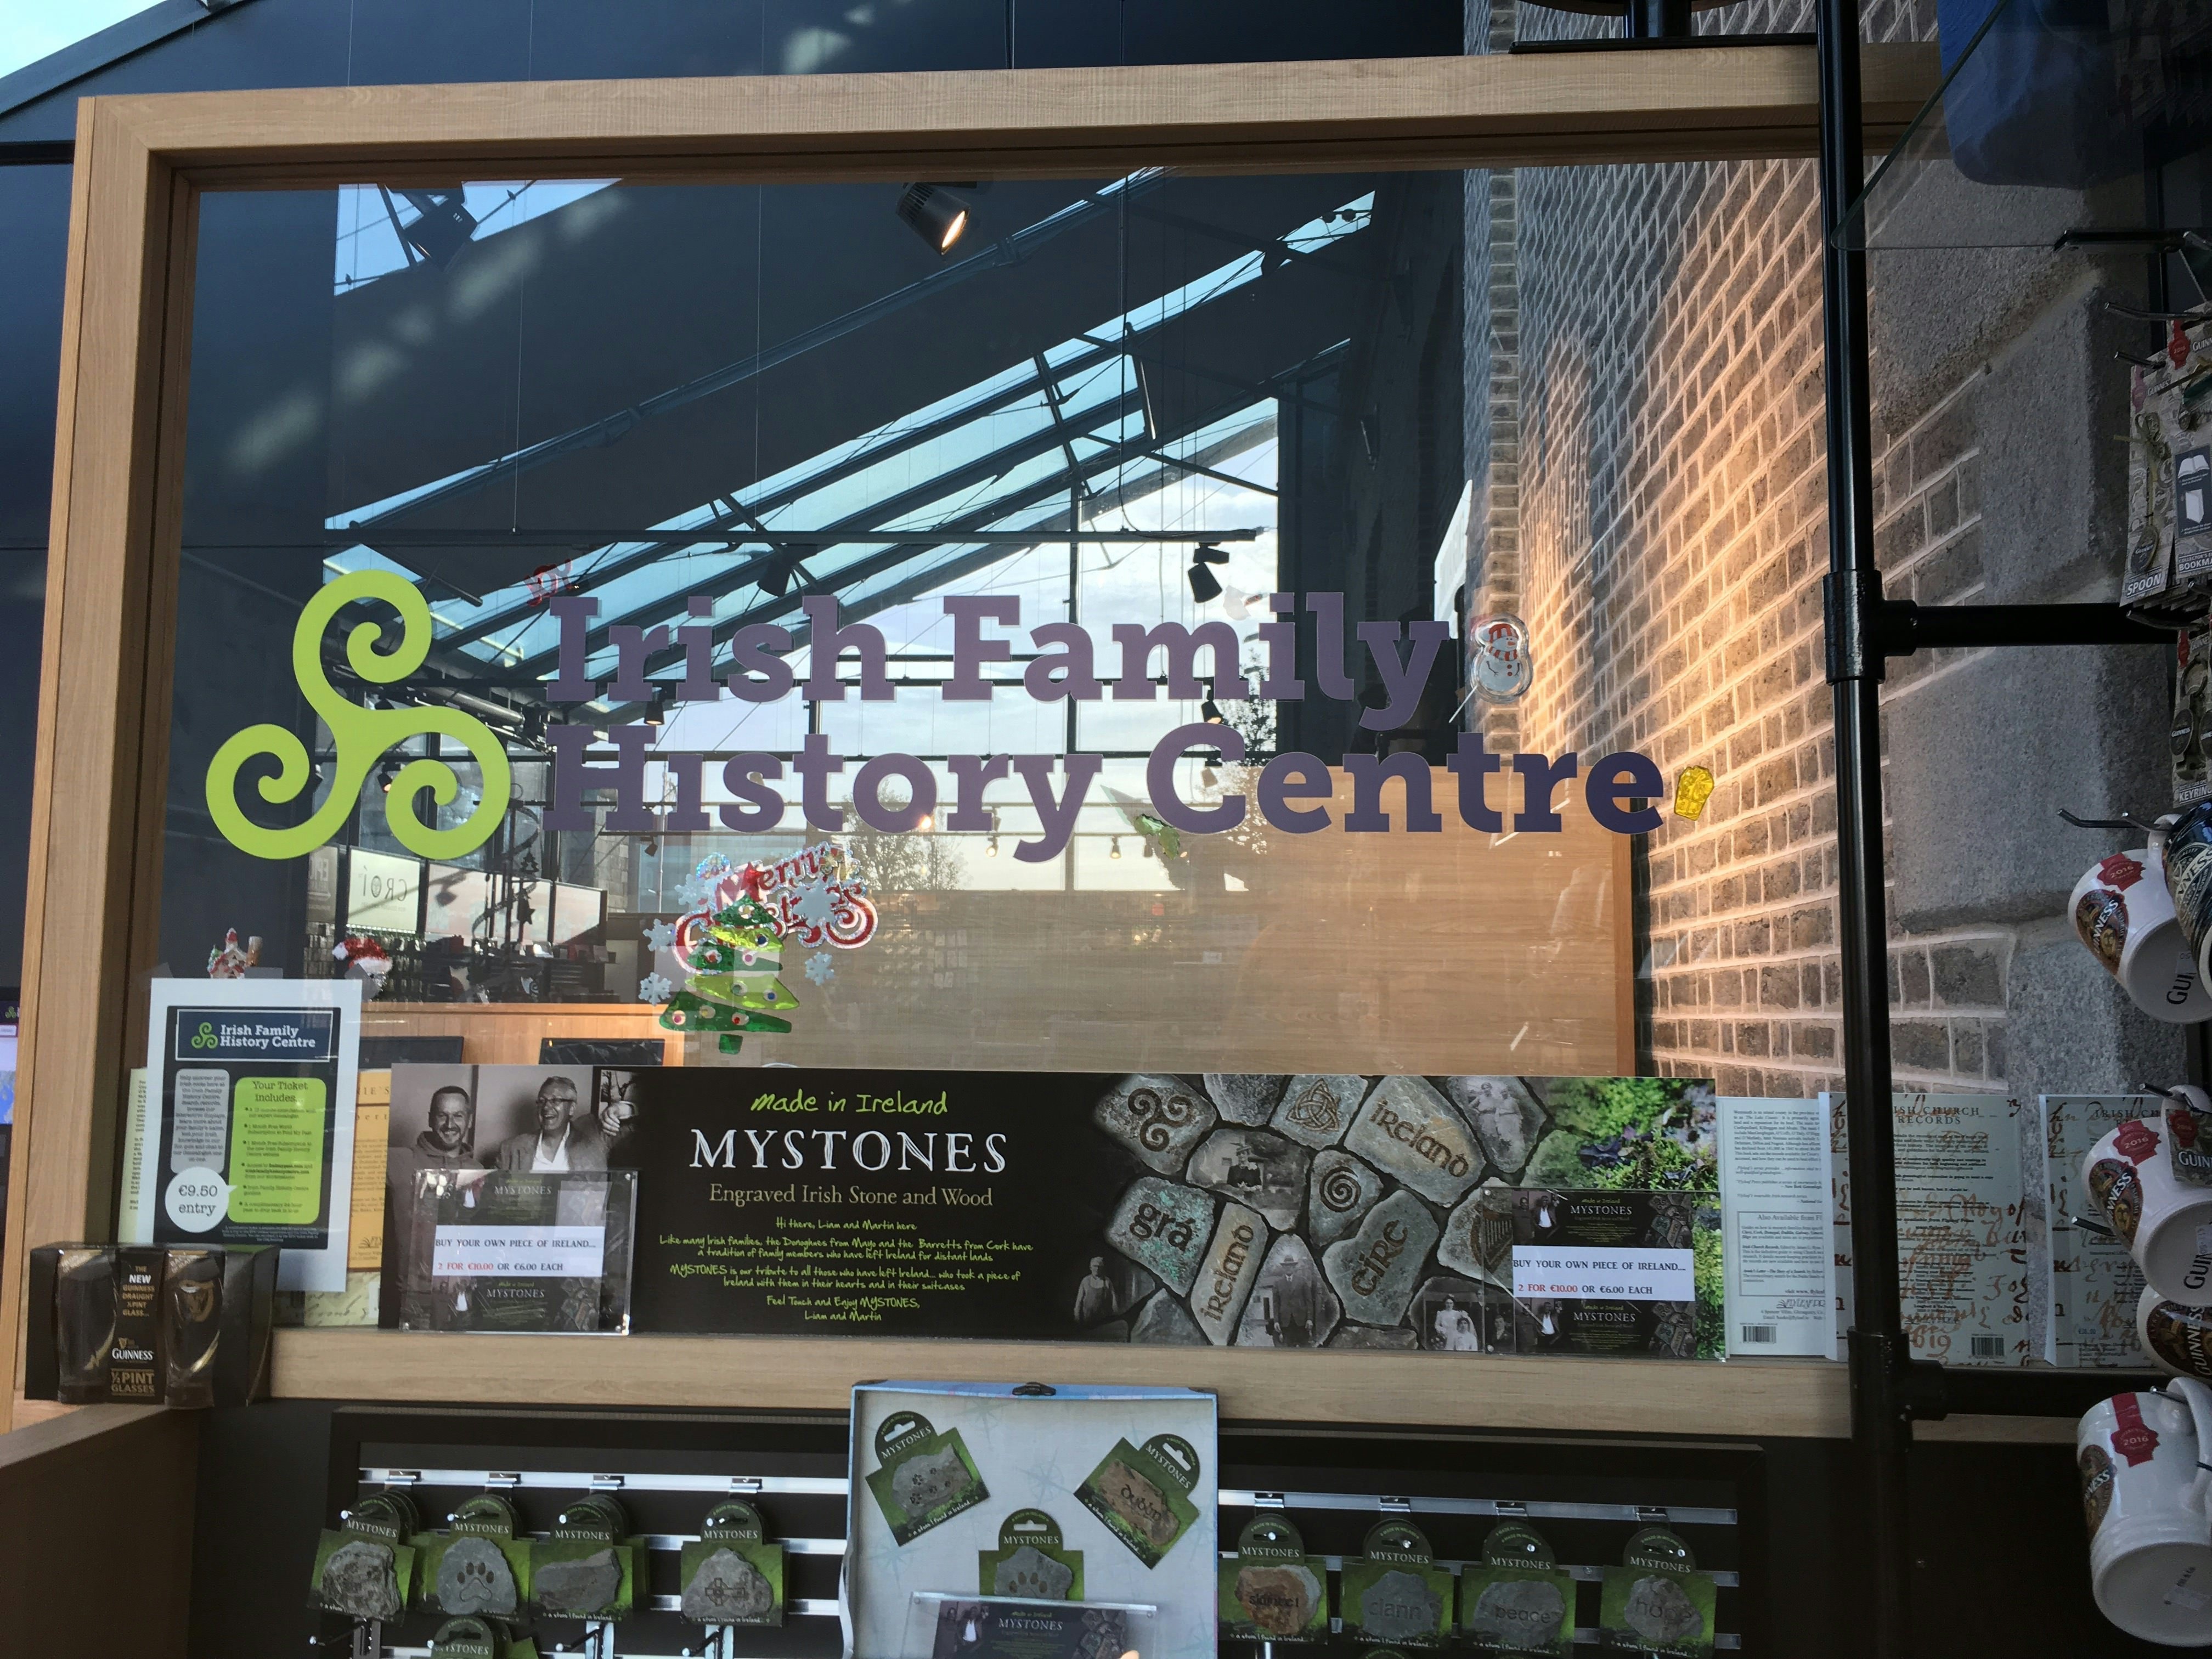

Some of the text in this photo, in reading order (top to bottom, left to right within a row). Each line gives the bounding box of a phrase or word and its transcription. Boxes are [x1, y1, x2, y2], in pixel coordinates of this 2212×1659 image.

[2127, 573, 2162, 596] SPOON
[549, 592, 1450, 731] Irish Family
[544, 723, 1664, 864] History Centre
[2111, 866, 2134, 878] 2016
[221, 1024, 299, 1037] Irish Family
[220, 1036, 316, 1049] History Centre
[252, 1081, 308, 1090] Your Ticket
[750, 1088, 947, 1115] made in Ireland
[1923, 1107, 1979, 1115] CHURCH
[2096, 1109, 2133, 1118] IRISH
[1898, 1116, 1961, 1125] RECORDS
[2124, 1137, 2149, 1149] 2016
[690, 1129, 1006, 1173] MYSTONES
[179, 1184, 217, 1197] €9.50
[495, 1185, 552, 1195] MYSTONES
[710, 1184, 992, 1207] Engraved Irish Stone and Wood
[179, 1203, 216, 1217] entry
[1570, 1205, 1632, 1215] MYSTONES
[776, 1217, 786, 1228] Hi
[819, 1220, 840, 1229] Liam
[862, 1220, 894, 1229] Martin
[659, 1234, 681, 1244] Like
[683, 1238, 706, 1249] many
[707, 1236, 725, 1245] Irish
[766, 1237, 780, 1246] the
[783, 1237, 827, 1250] Donoghues
[830, 1238, 849, 1247] from
[852, 1238, 877, 1252] Mayo
[879, 1240, 895, 1248] and
[898, 1239, 913, 1248] the
[918, 1238, 962, 1249] Barretts
[964, 1240, 984, 1250] from
[986, 1241, 1010, 1250] Cork
[707, 1248, 744, 1257] tradition
[747, 1248, 757, 1257] of
[758, 1248, 784, 1261] family
[786, 1248, 823, 1257] members
[865, 1250, 883, 1259] left
[885, 1250, 916, 1260] Ireland
[918, 1251, 931, 1260] for
[935, 1252, 967, 1260] distant
[970, 1253, 992, 1261] lands
[514, 1263, 537, 1271] €6.00
[1536, 1260, 1561, 1268] YOUR
[1565, 1261, 1588, 1269] OWN
[1622, 1262, 1634, 1270] OF
[129, 1274, 151, 1284] NEW
[670, 1264, 727, 1277] MYSTONES
[755, 1266, 787, 1276] tribute
[789, 1267, 799, 1276] to
[801, 1265, 811, 1276] all
[814, 1266, 838, 1276] those
[878, 1267, 896, 1277] left
[957, 1270, 974, 1279] took
[986, 1272, 1009, 1282] piece
[1011, 1272, 1020, 1280] of
[724, 1277, 754, 1286] Ireland
[757, 1278, 775, 1286] with
[778, 1278, 799, 1287] them
[812, 1278, 832, 1288] their
[836, 1277, 866, 1289] hearts
[869, 1281, 885, 1289] and
[898, 1281, 919, 1289] their
[922, 1282, 965, 1290] suitcases
[1550, 1284, 1578, 1293] €10.00
[1600, 1285, 1624, 1294] €6.00
[487, 1289, 545, 1299] MYSTONES
[767, 1295, 786, 1305] Feel
[789, 1296, 811, 1306] Touch
[834, 1297, 857, 1311] Enjoy
[805, 1307, 881, 1321] Liam and Martin
[1573, 1312, 1636, 1322] MYSTONES
[112, 1347, 154, 1361] GUINNESS
[122, 1372, 154, 1385] PINT
[111, 1385, 155, 1393] GLASSES
[881, 1426, 931, 1459] MYSTONES
[2124, 1436, 2149, 1446] 2016
[1146, 1444, 1191, 1488] MYSTONES
[346, 1519, 398, 1537] MYSTONES
[454, 1522, 509, 1534] MYSTONES
[703, 1529, 758, 1539] MYSTONES
[555, 1529, 610, 1541] MYSTONES
[1004, 1536, 1059, 1544] MYSTONES
[1242, 1546, 1299, 1558] MYSTONES
[1370, 1550, 1429, 1564] MYSTONES
[1491, 1556, 1551, 1570] MYSTONES
[1630, 1556, 1691, 1573] MYSTONES
[1495, 1604, 1551, 1624] peace
[998, 1618, 1063, 1630] MYSTONES
